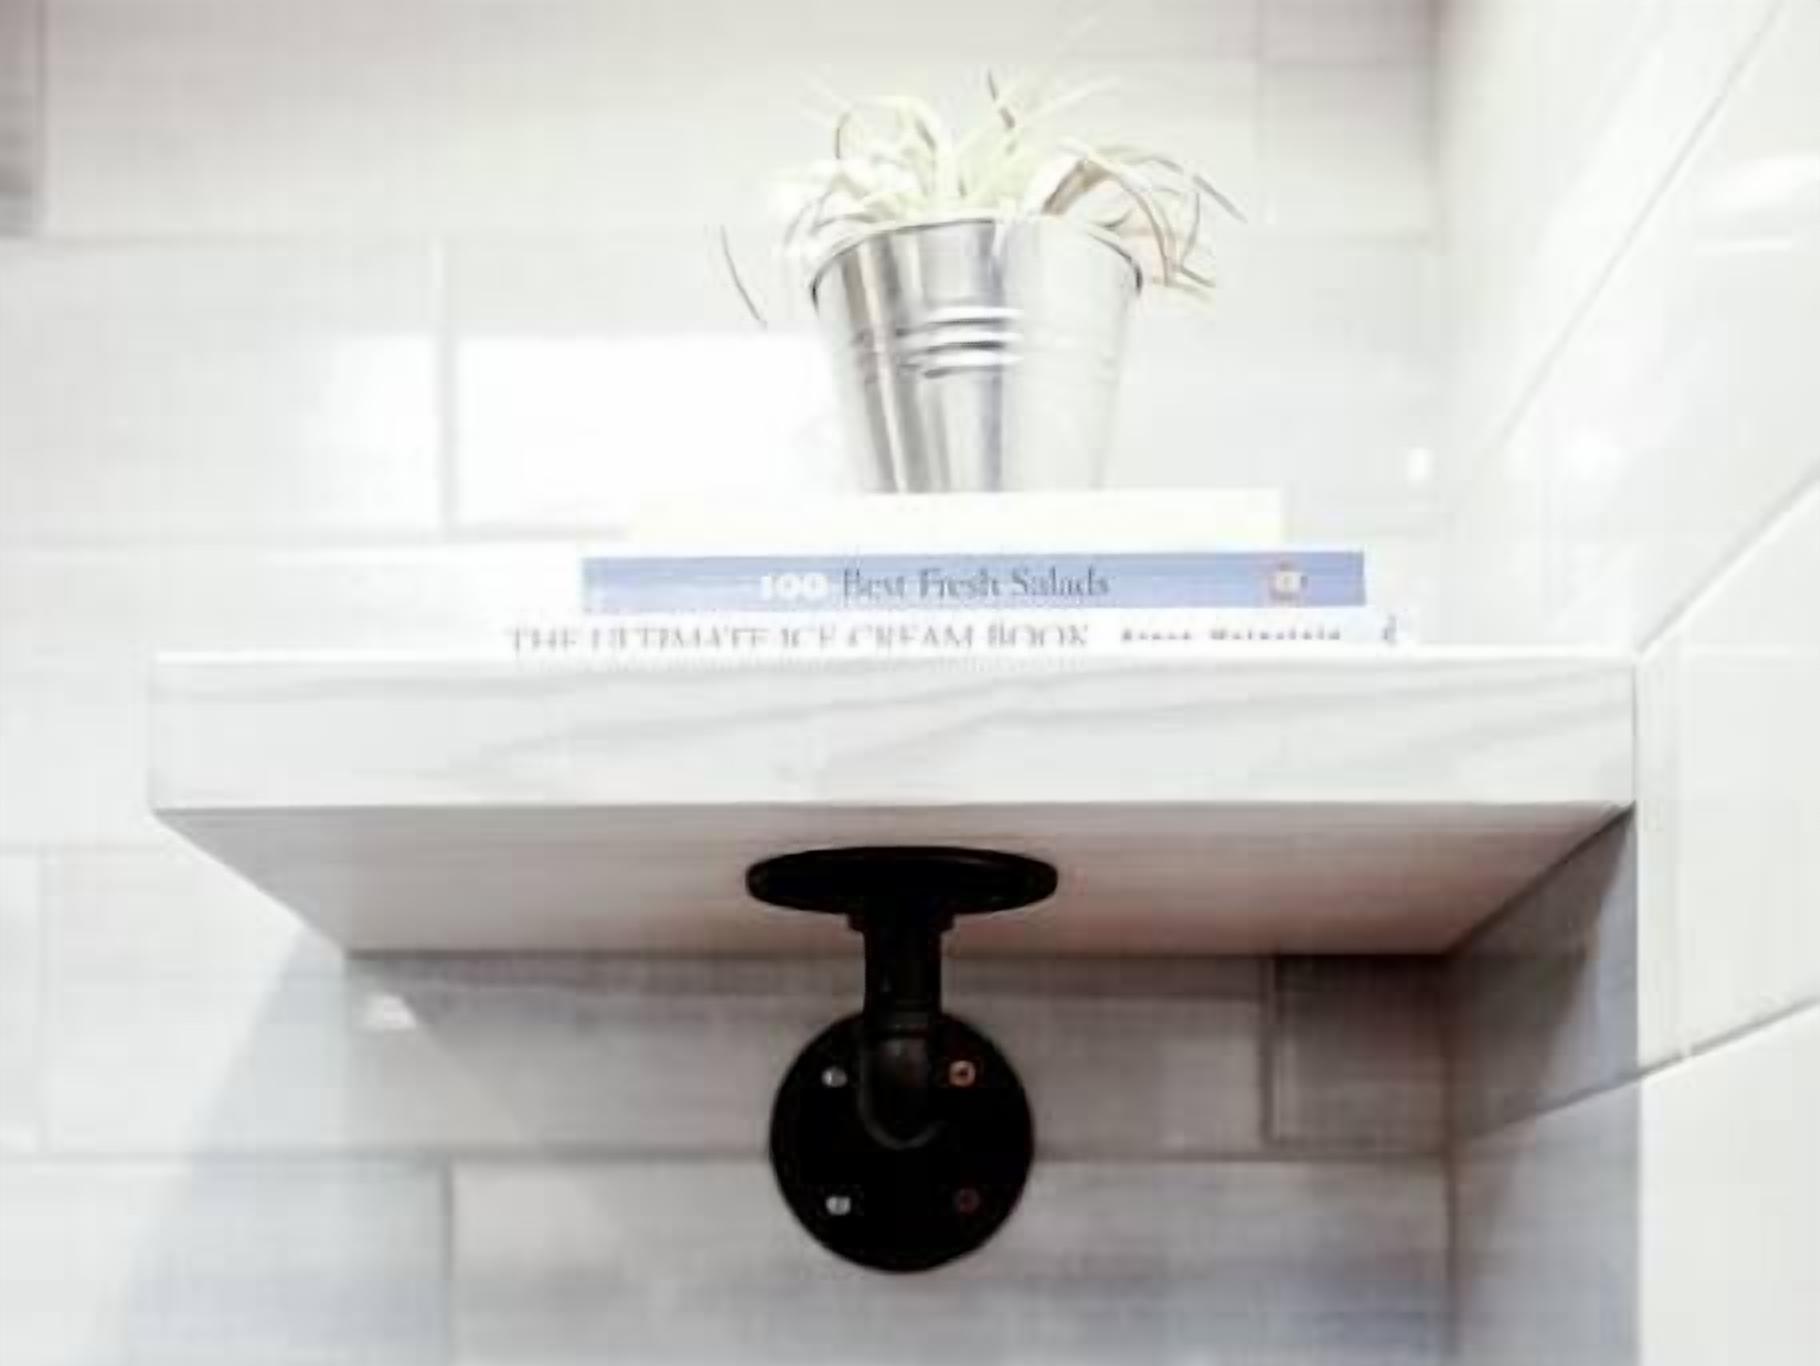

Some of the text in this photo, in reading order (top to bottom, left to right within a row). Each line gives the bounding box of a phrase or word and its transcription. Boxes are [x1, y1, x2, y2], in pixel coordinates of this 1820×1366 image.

[842, 567, 905, 598] Best
[919, 566, 1000, 597] Fresh
[1012, 565, 1110, 596] Salads
